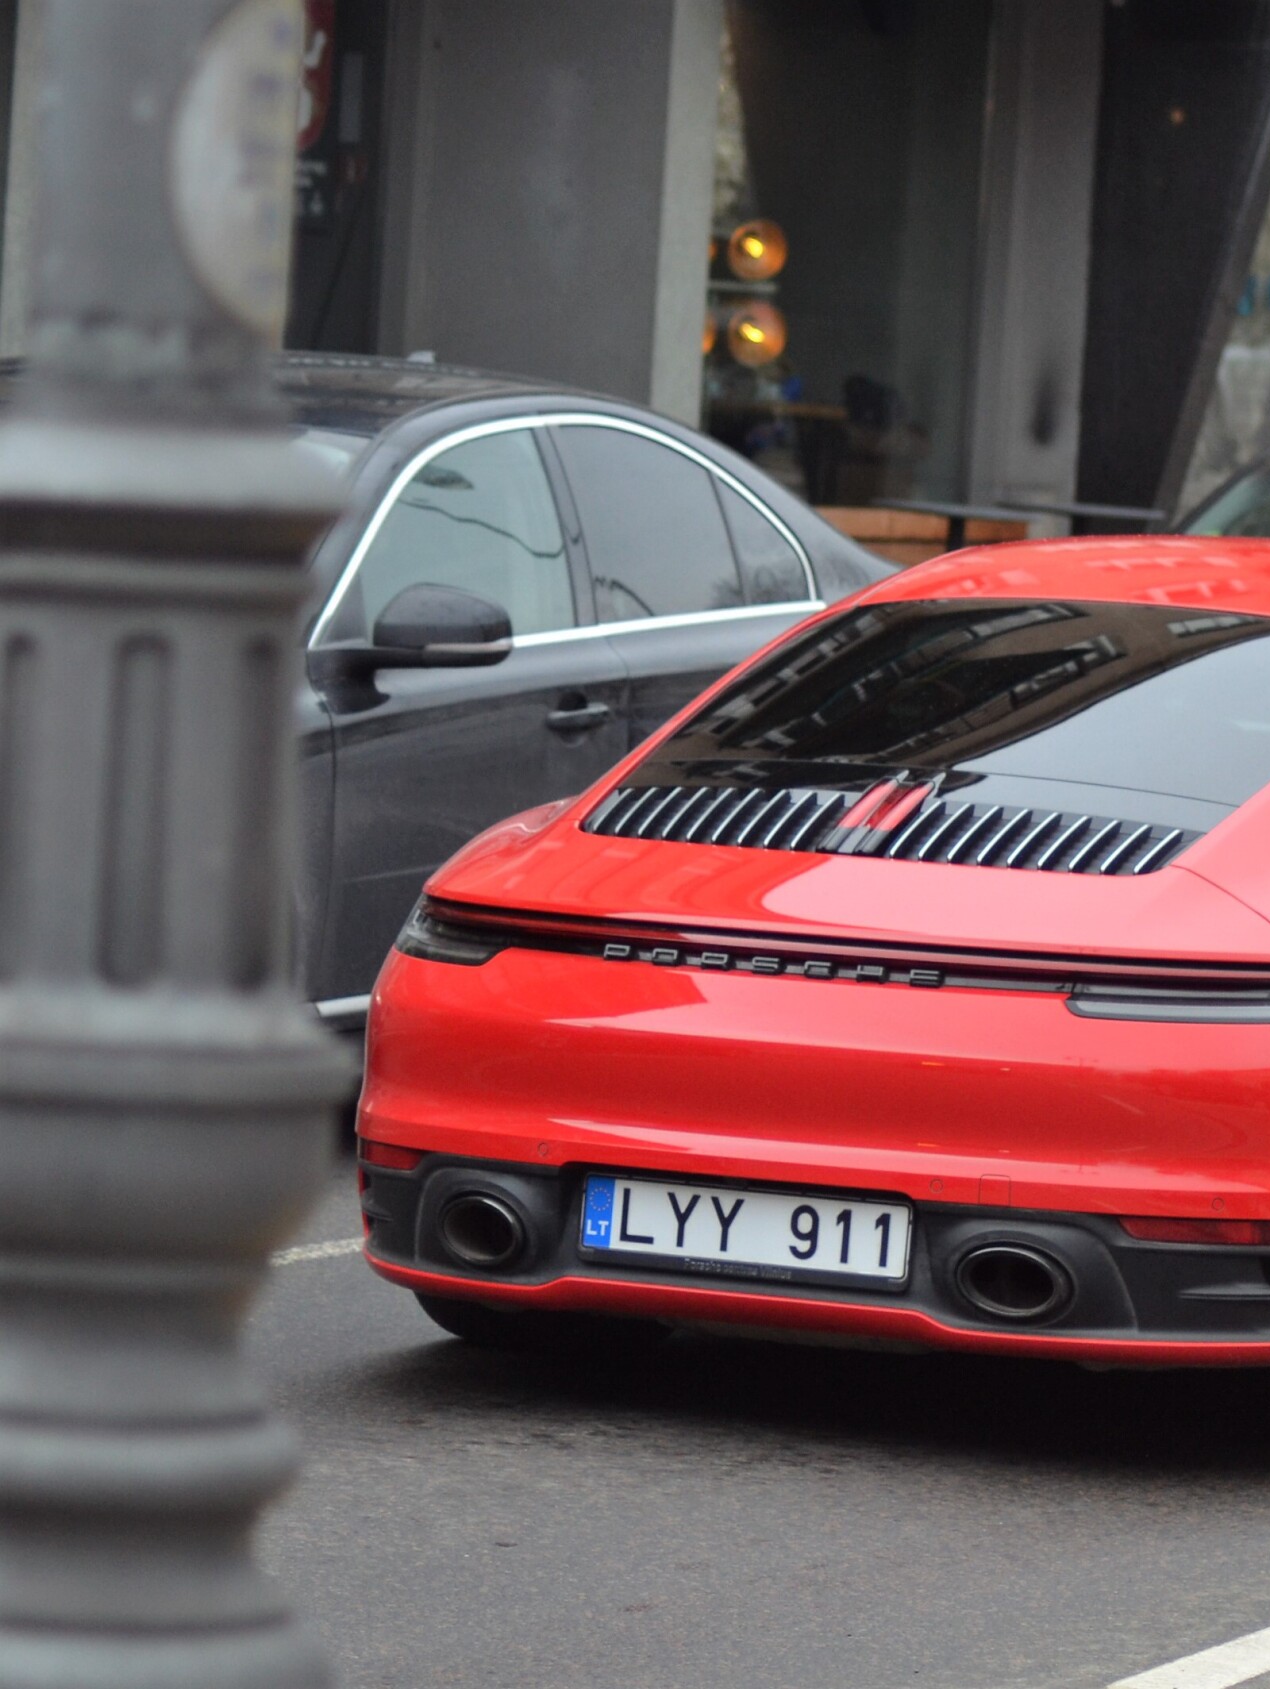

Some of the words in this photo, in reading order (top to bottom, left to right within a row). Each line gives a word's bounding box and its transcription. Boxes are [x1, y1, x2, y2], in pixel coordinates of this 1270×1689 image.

[603, 943, 944, 988] PORSCHE
[586, 1218, 609, 1237] LT
[619, 1187, 746, 1252] LYY
[789, 1204, 892, 1268] 911
